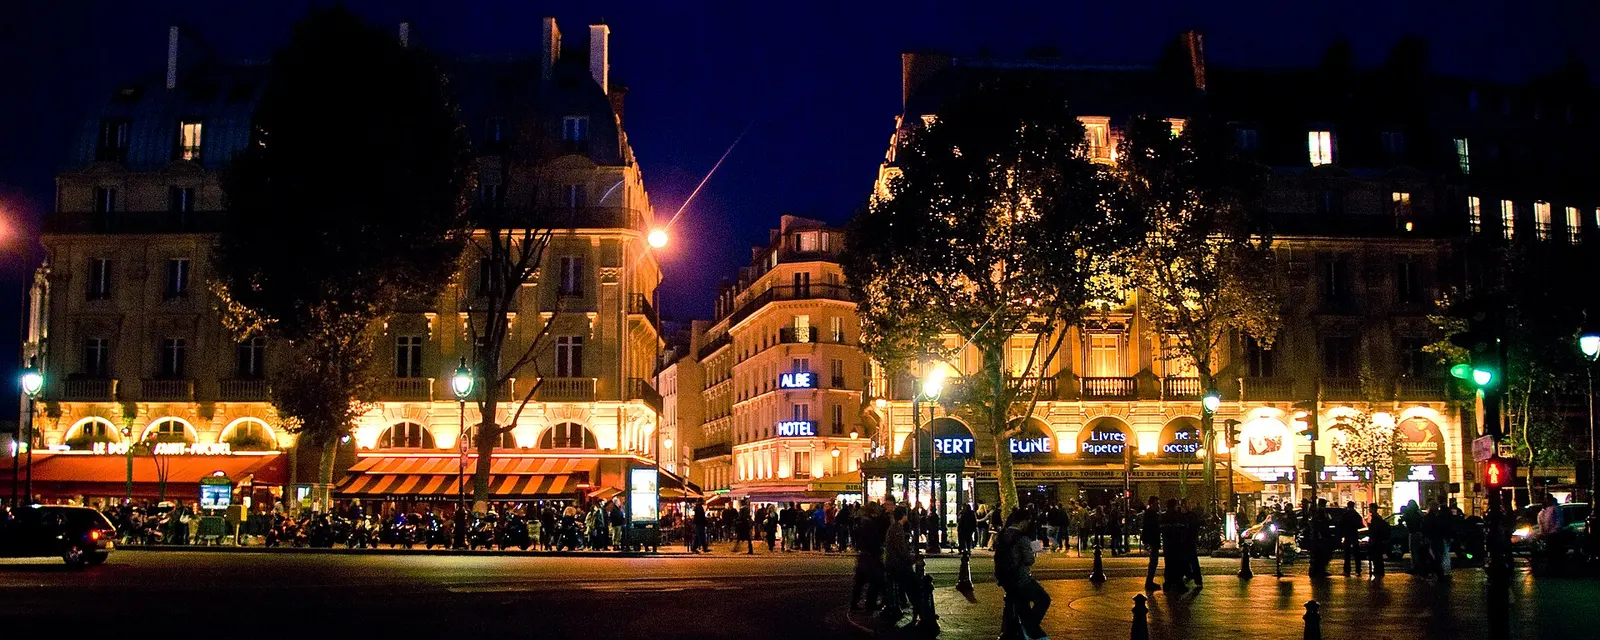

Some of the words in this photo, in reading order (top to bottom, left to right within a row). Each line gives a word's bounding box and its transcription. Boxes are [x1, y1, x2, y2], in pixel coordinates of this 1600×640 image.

[781, 372, 810, 388] ALBE
[778, 421, 814, 436] HOTEL
[1091, 431, 1127, 441] Livres
[934, 438, 974, 454] BERT
[1009, 437, 1052, 453] EUNE
[1081, 442, 1127, 456] Papeter
